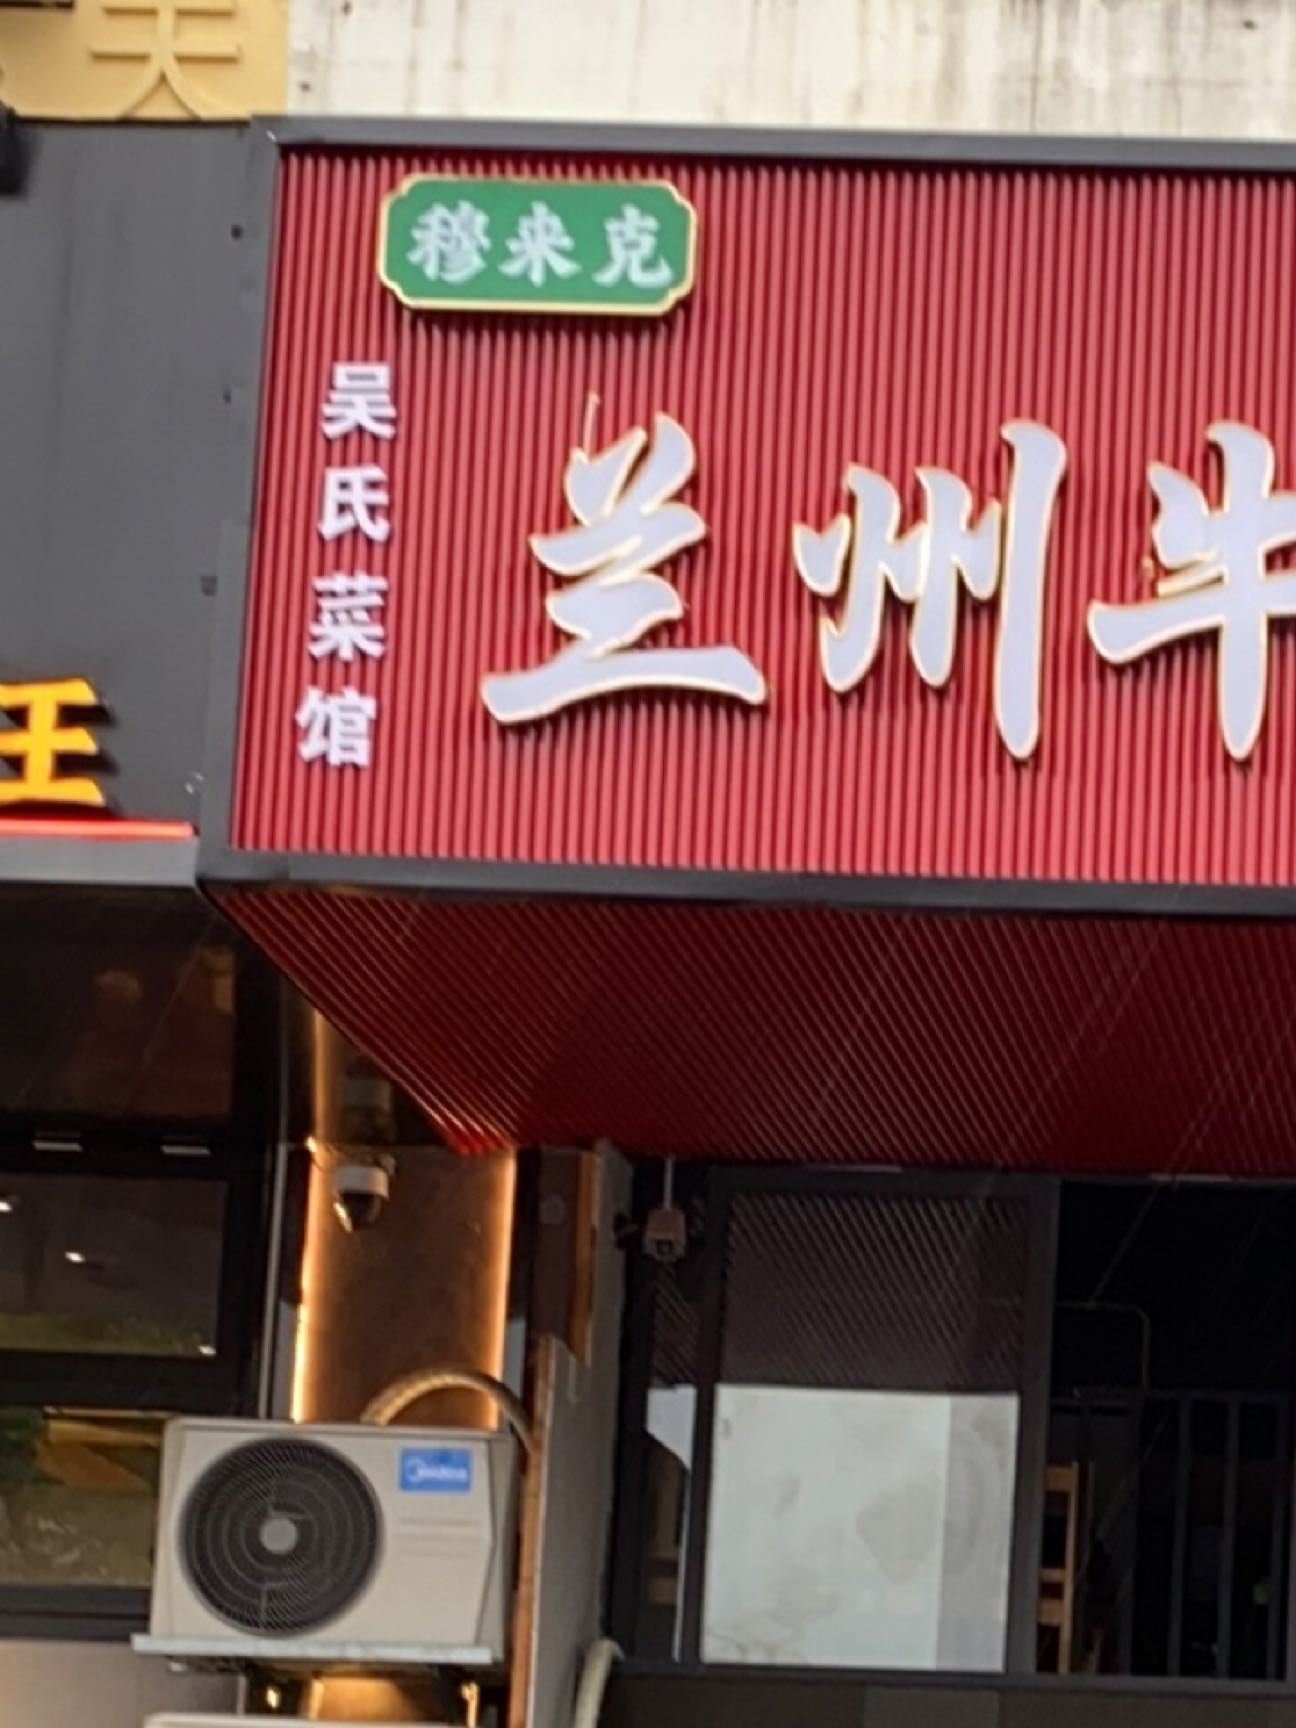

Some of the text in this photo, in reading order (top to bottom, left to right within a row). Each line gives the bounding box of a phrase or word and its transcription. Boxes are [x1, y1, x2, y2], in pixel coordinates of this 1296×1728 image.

[406, 200, 675, 288] 穆来克
[295, 361, 397, 768] 吴氏菜馆
